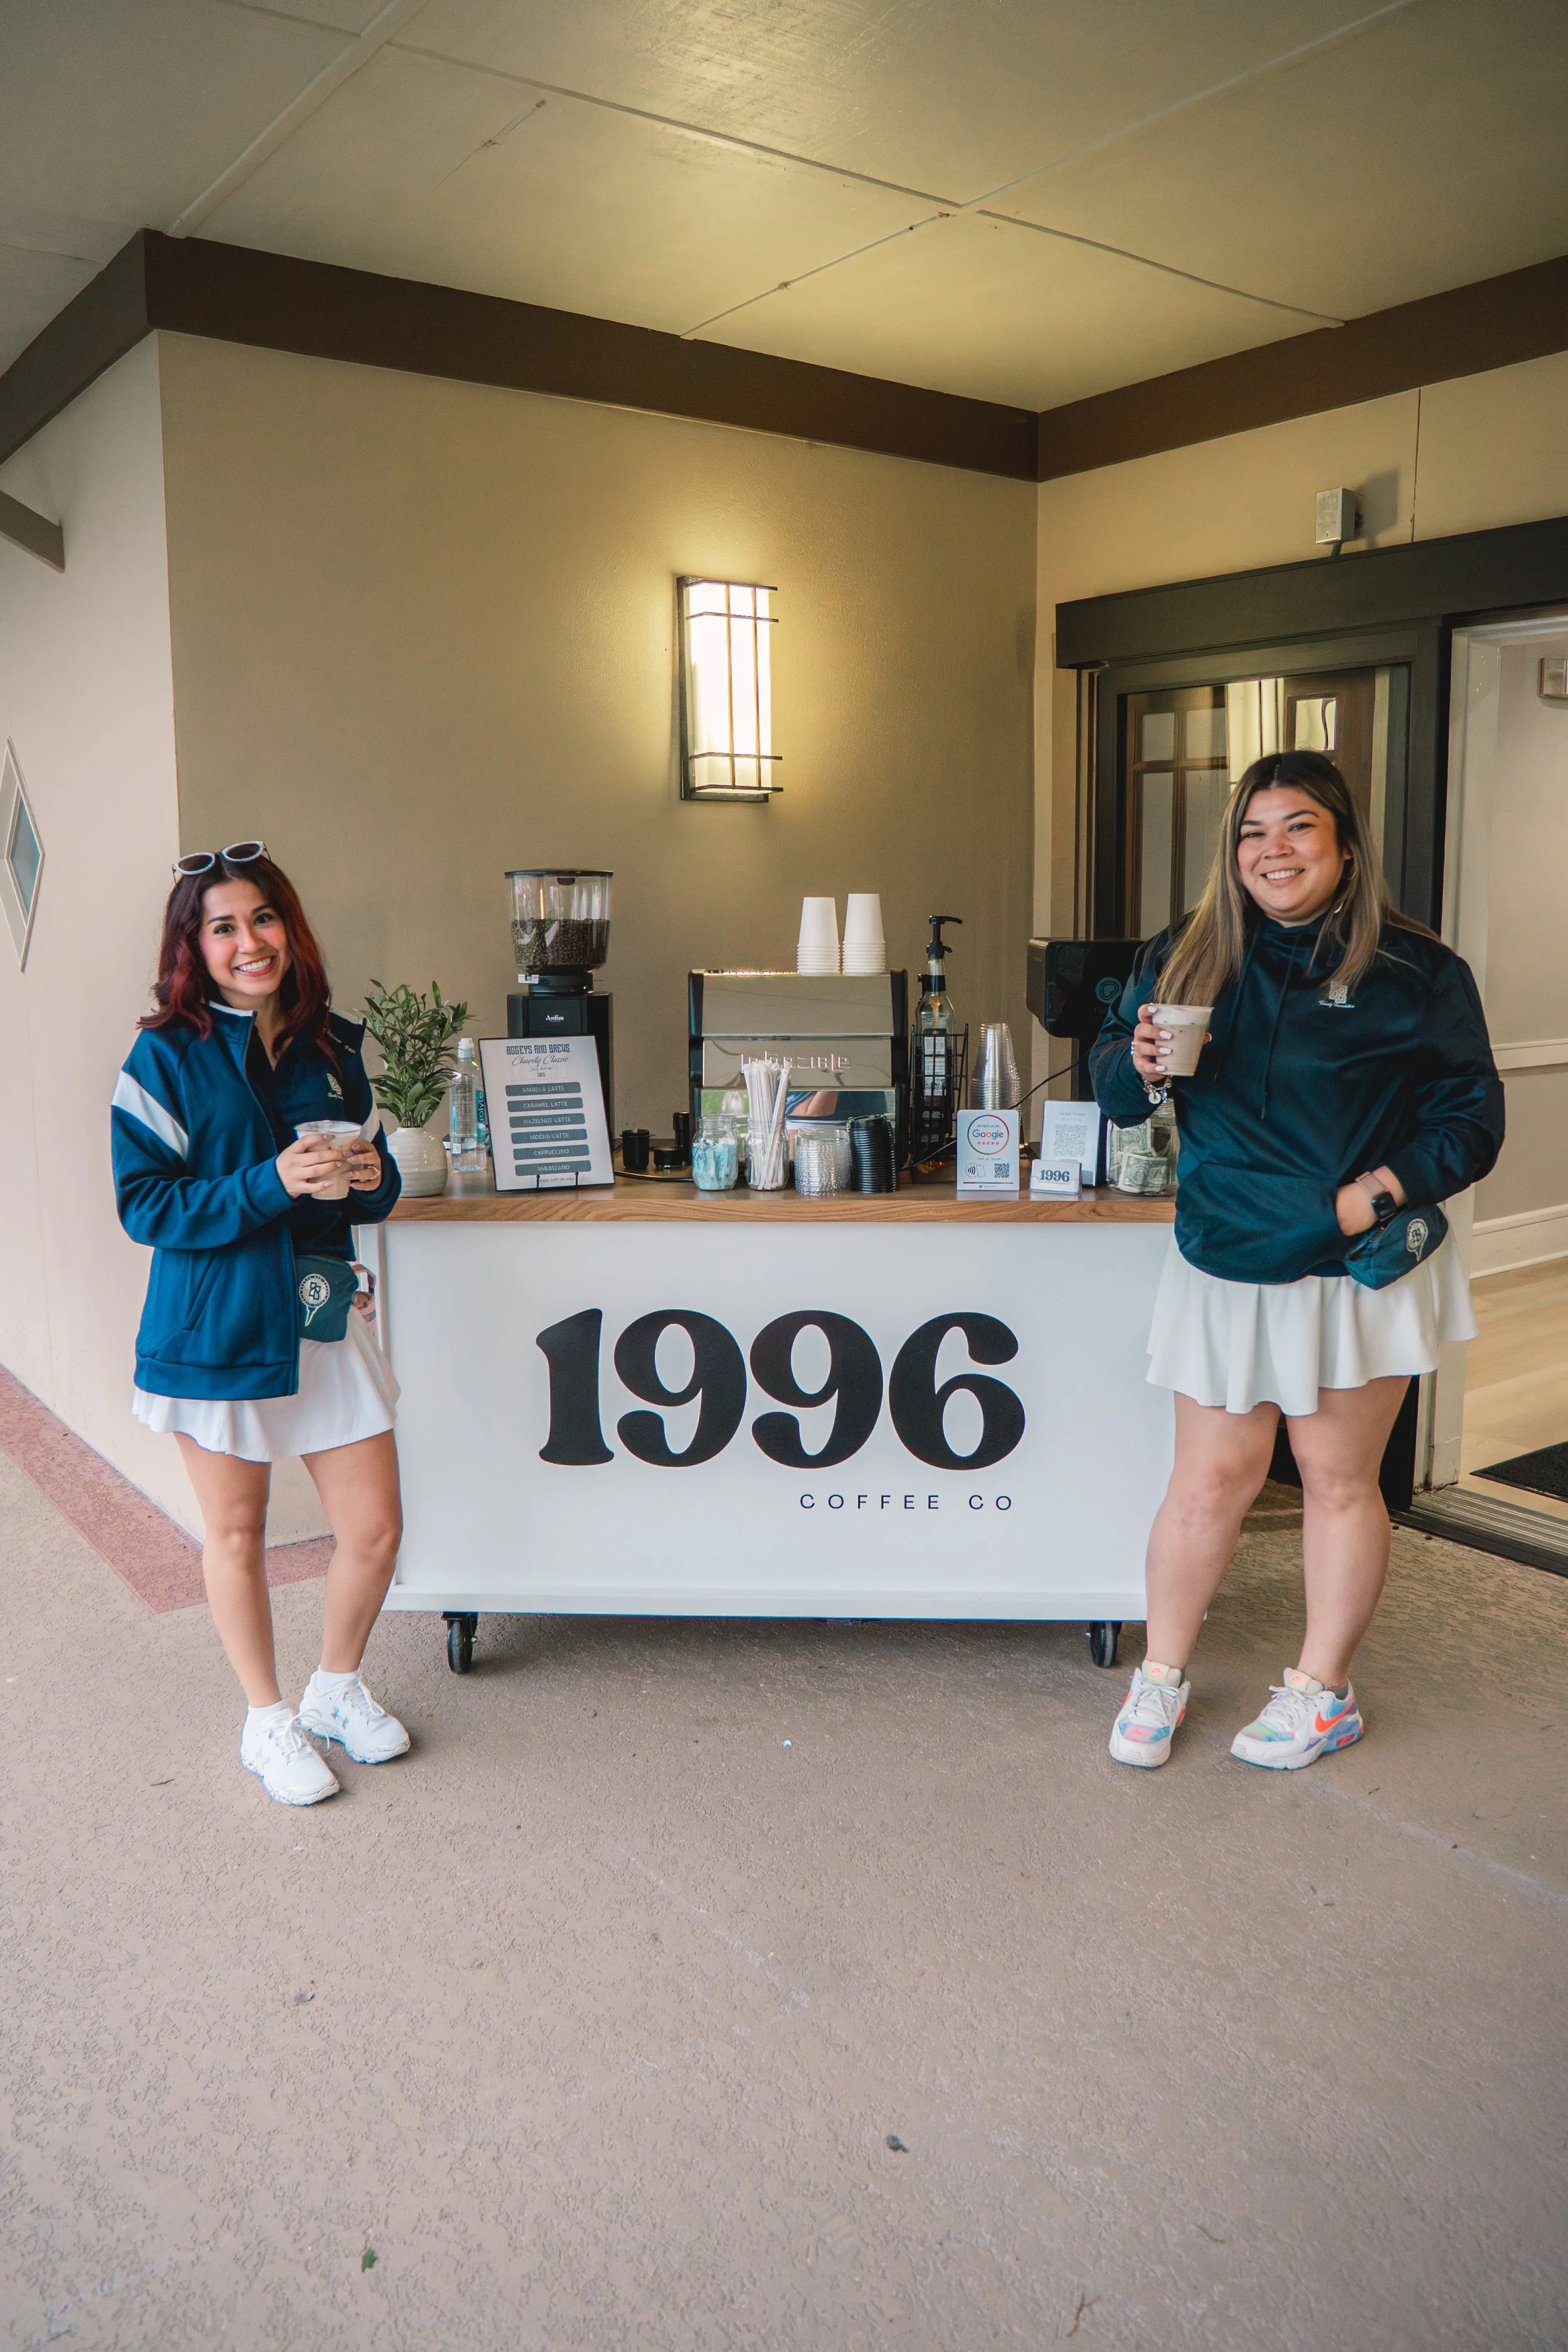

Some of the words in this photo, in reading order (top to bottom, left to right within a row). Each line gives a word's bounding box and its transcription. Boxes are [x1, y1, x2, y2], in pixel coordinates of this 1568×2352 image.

[506, 1045, 533, 1055] BOGEYS
[534, 1044, 548, 1054] AND
[512, 1056, 542, 1067] Charity
[543, 1054, 569, 1065] Classic
[972, 1129, 1004, 1140] Google
[1040, 1169, 1070, 1182] 1996
[536, 1308, 1025, 1470] 1996
[800, 1494, 939, 1509] COFFEE
[968, 1495, 1012, 1510] CO
